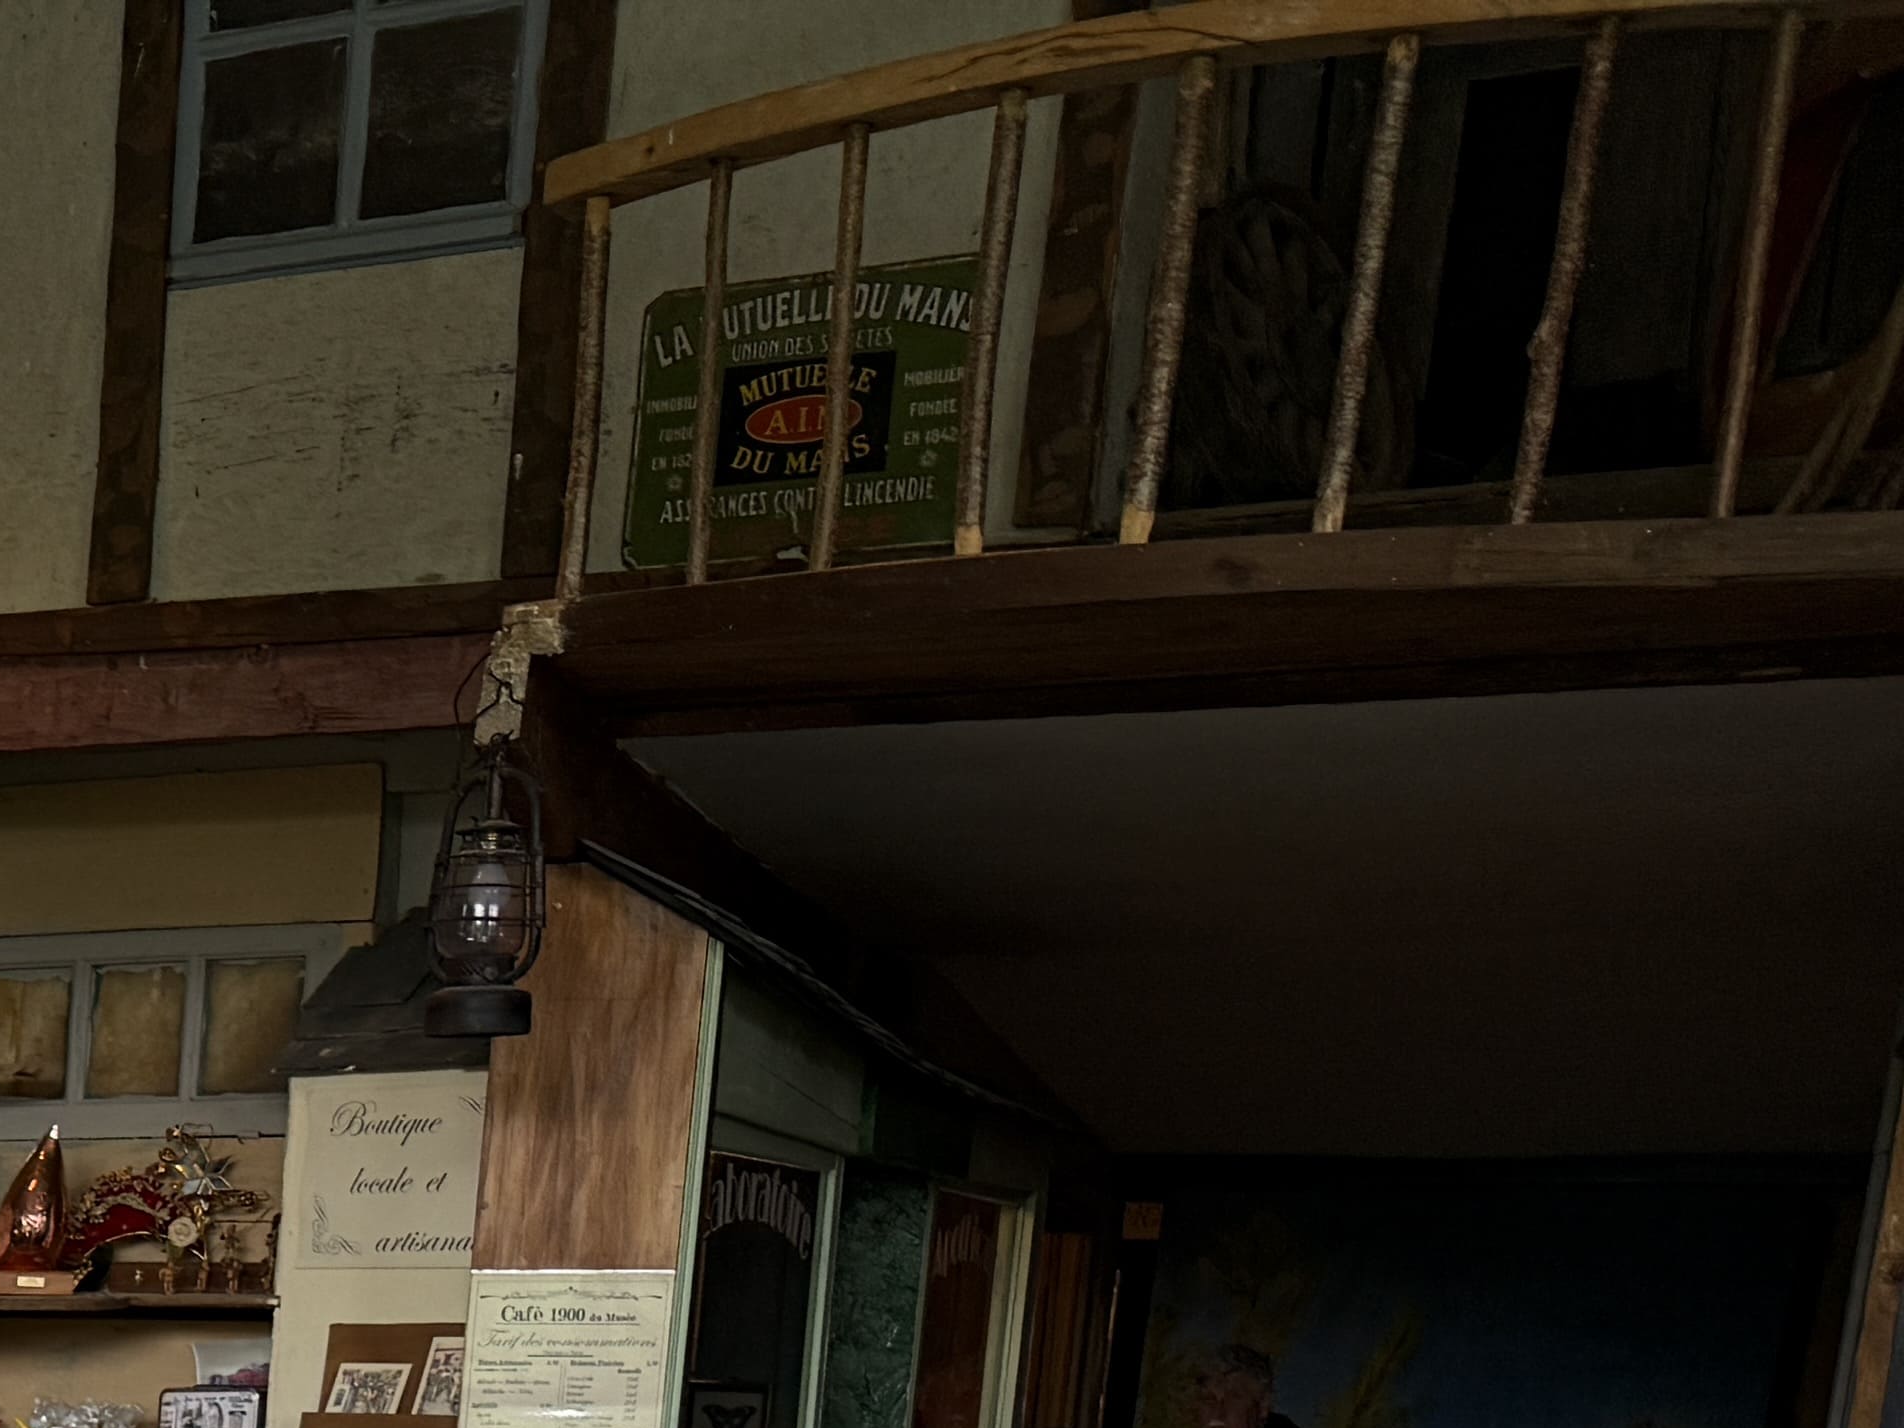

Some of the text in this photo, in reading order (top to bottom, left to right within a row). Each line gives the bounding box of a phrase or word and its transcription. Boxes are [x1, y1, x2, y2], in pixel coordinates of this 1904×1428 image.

[655, 325, 694, 369] LA
[854, 282, 892, 320] DU
[731, 445, 776, 475] DU
[329, 1100, 443, 1146] Boutique
[349, 1166, 449, 1195] locale et
[375, 1231, 474, 1253] artisana
[550, 1307, 586, 1323] 1900
